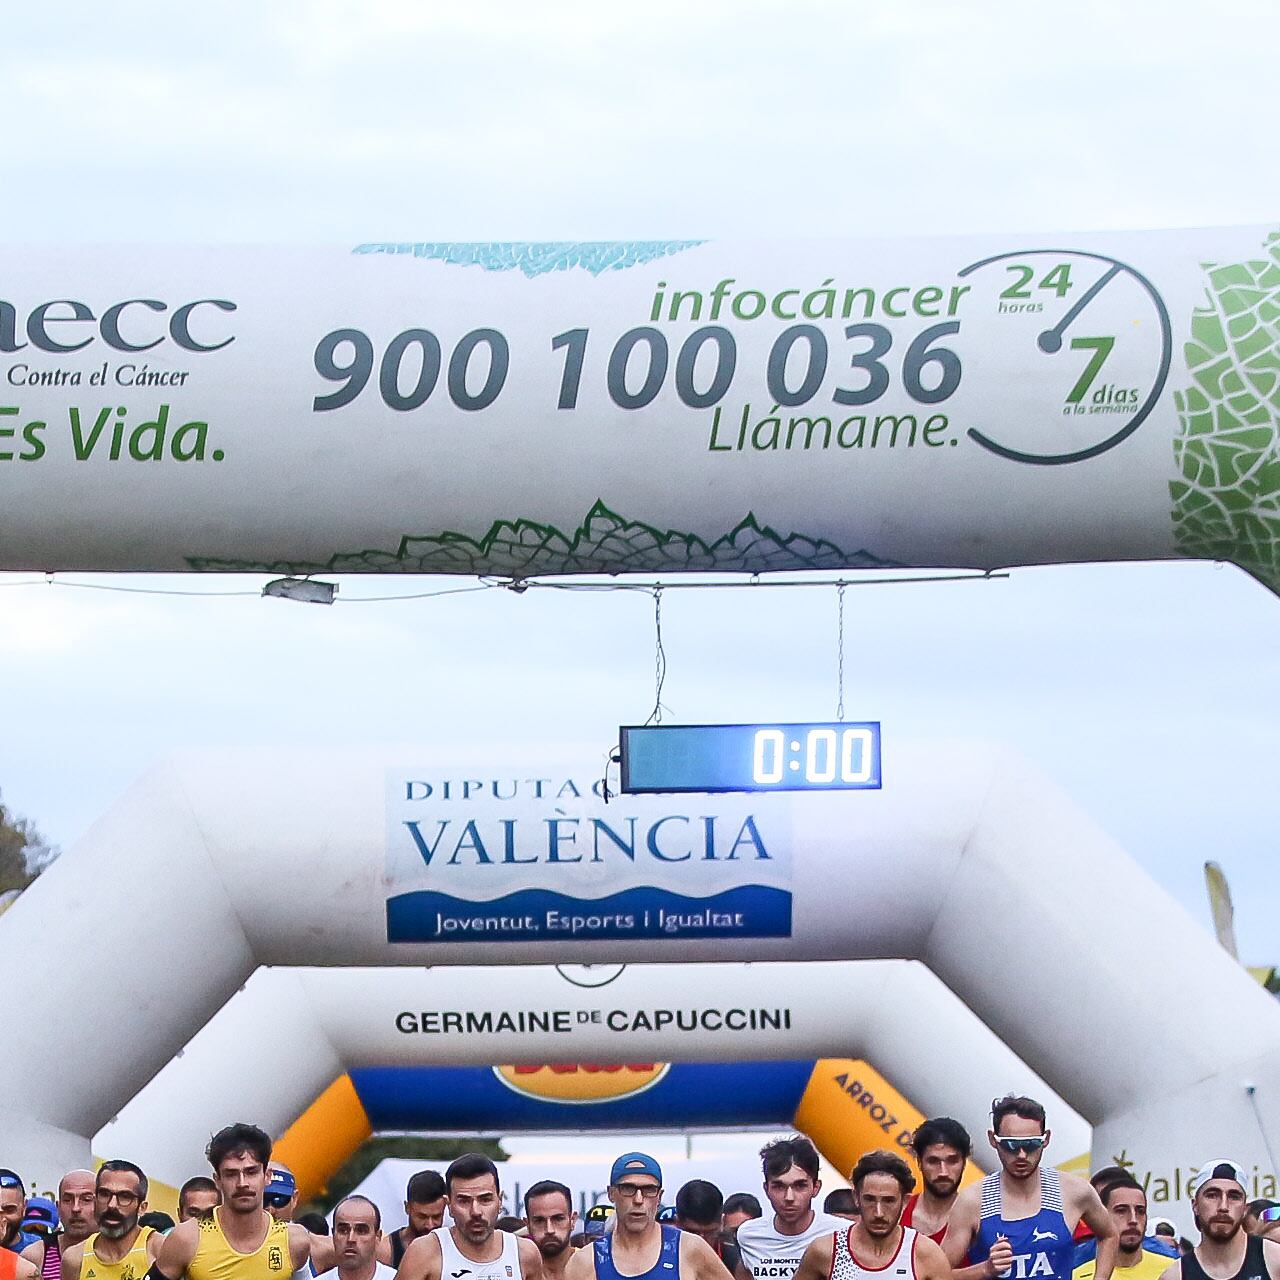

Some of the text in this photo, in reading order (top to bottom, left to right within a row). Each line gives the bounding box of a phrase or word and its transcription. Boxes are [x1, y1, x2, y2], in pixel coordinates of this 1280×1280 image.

[999, 263, 1073, 299] 24
[649, 278, 971, 323] infocáncer
[998, 301, 1044, 313] horas
[7, 362, 190, 388] Contra el Cáncer
[312, 321, 962, 413] 900 100 036
[1064, 336, 1116, 404] 7
[1089, 404, 1138, 415] semana
[1093, 384, 1139, 406] días
[68, 404, 226, 462] Vida.
[708, 400, 960, 452] Llámame.
[753, 728, 873, 784] 0:00
[405, 778, 619, 801] DIPUTAC
[401, 807, 774, 867] VALÈNCIA
[434, 909, 745, 936] Joventut, Esports i Igualtat
[395, 1008, 792, 1035] GERMAINE DE CAPUCCINI
[834, 1072, 898, 1134] ARROZ
[1133, 1165, 1278, 1203] Valèia
[753, 1266, 797, 1277] BACKY
